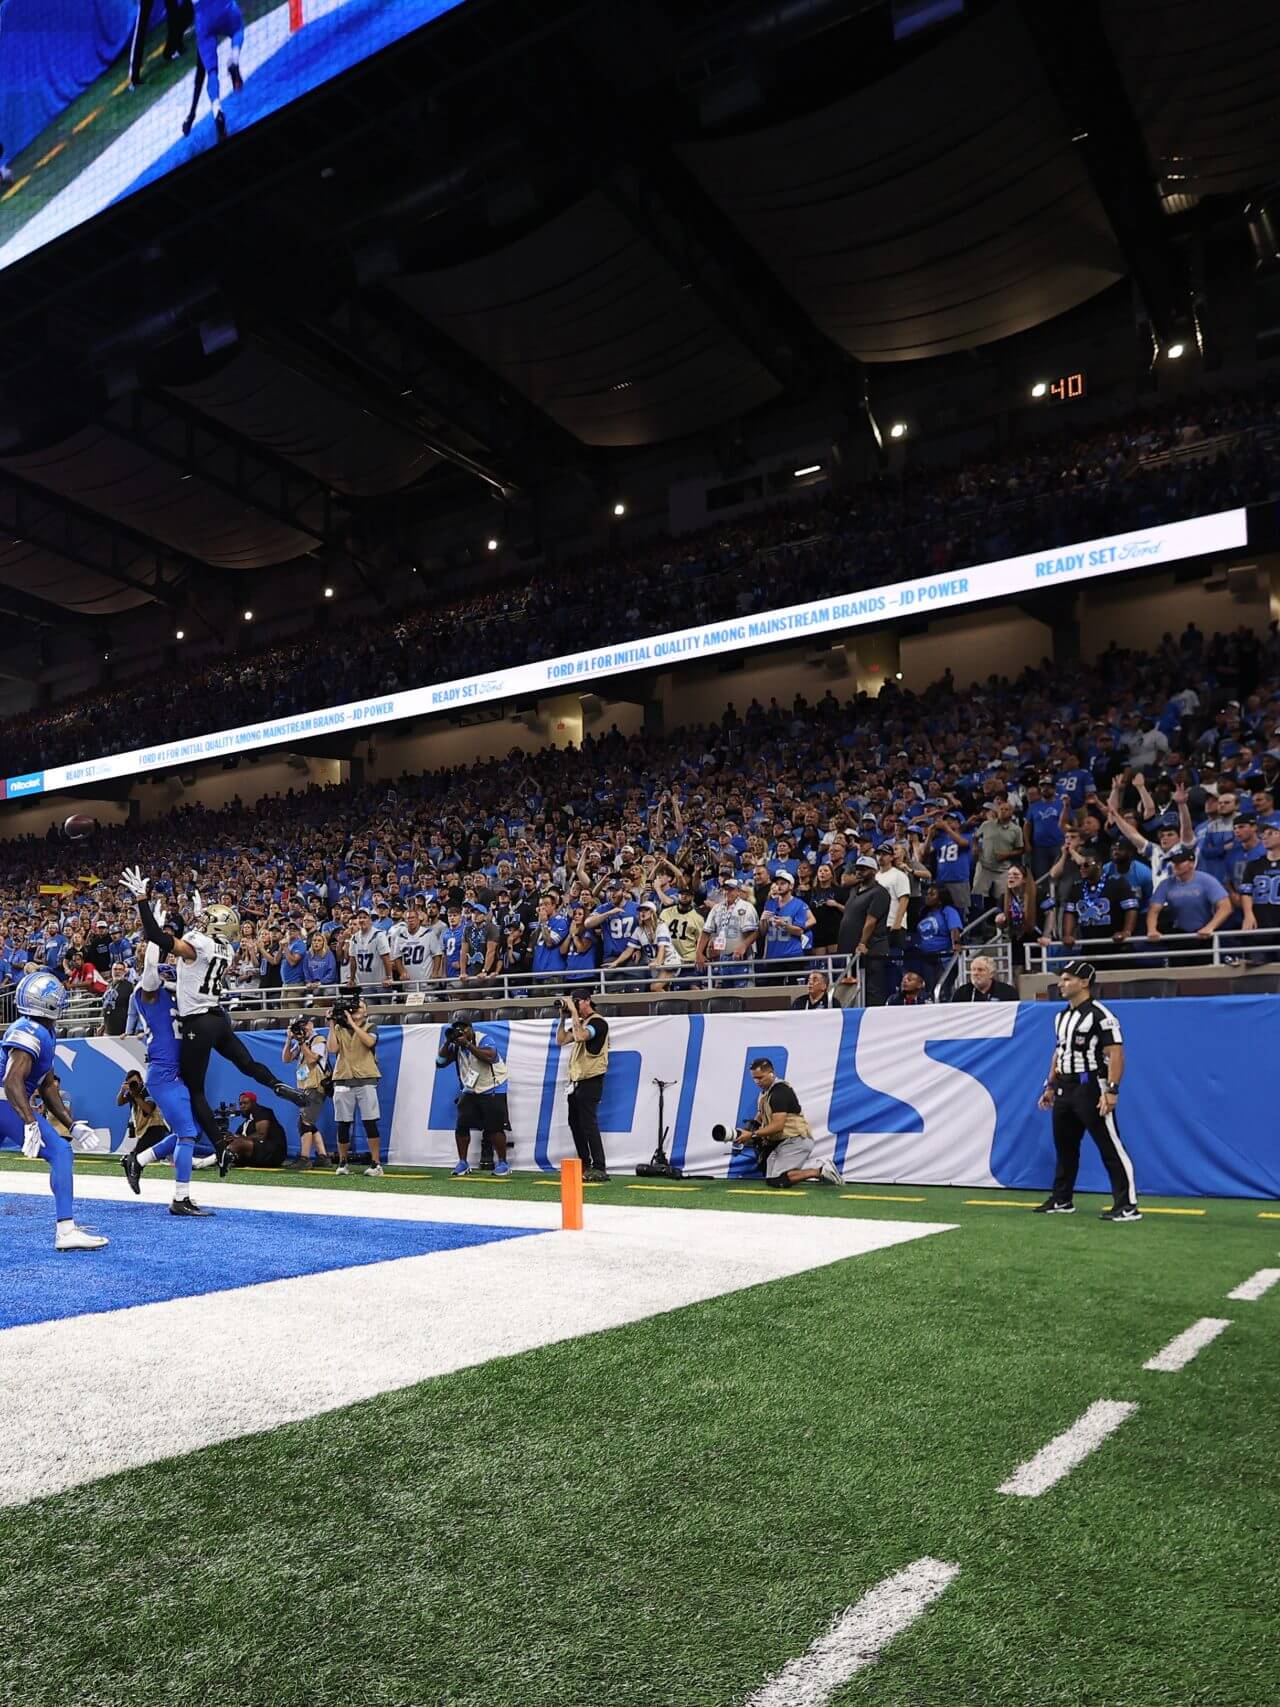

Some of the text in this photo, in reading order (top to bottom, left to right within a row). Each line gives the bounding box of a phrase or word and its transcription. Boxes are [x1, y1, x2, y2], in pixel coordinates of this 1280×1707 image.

[1050, 373, 1082, 400] 40
[1034, 553, 1085, 578] READY
[1088, 546, 1117, 566] SET
[546, 663, 575, 680] FORD
[576, 660, 590, 673] #1
[591, 654, 612, 670] FOR
[614, 647, 652, 666] INITIAL
[654, 635, 701, 657] QUALITY
[702, 625, 746, 647] AMONG
[748, 607, 830, 640] MAINSTREAM
[832, 596, 886, 621] BRANDS
[917, 577, 969, 602] POWER
[431, 686, 460, 705] READY
[462, 683, 479, 699] SET
[205, 736, 234, 752] QUALITY
[262, 719, 312, 739] MAINSTREAM
[313, 712, 345, 729] BRANDS
[363, 702, 395, 719] POWER
[938, 844, 959, 864] 18
[609, 916, 635, 940] 97
[668, 918, 689, 941] 41
[357, 953, 375, 973] 97
[401, 945, 425, 966] 20
[384, 998, 1021, 1188] LIONS
